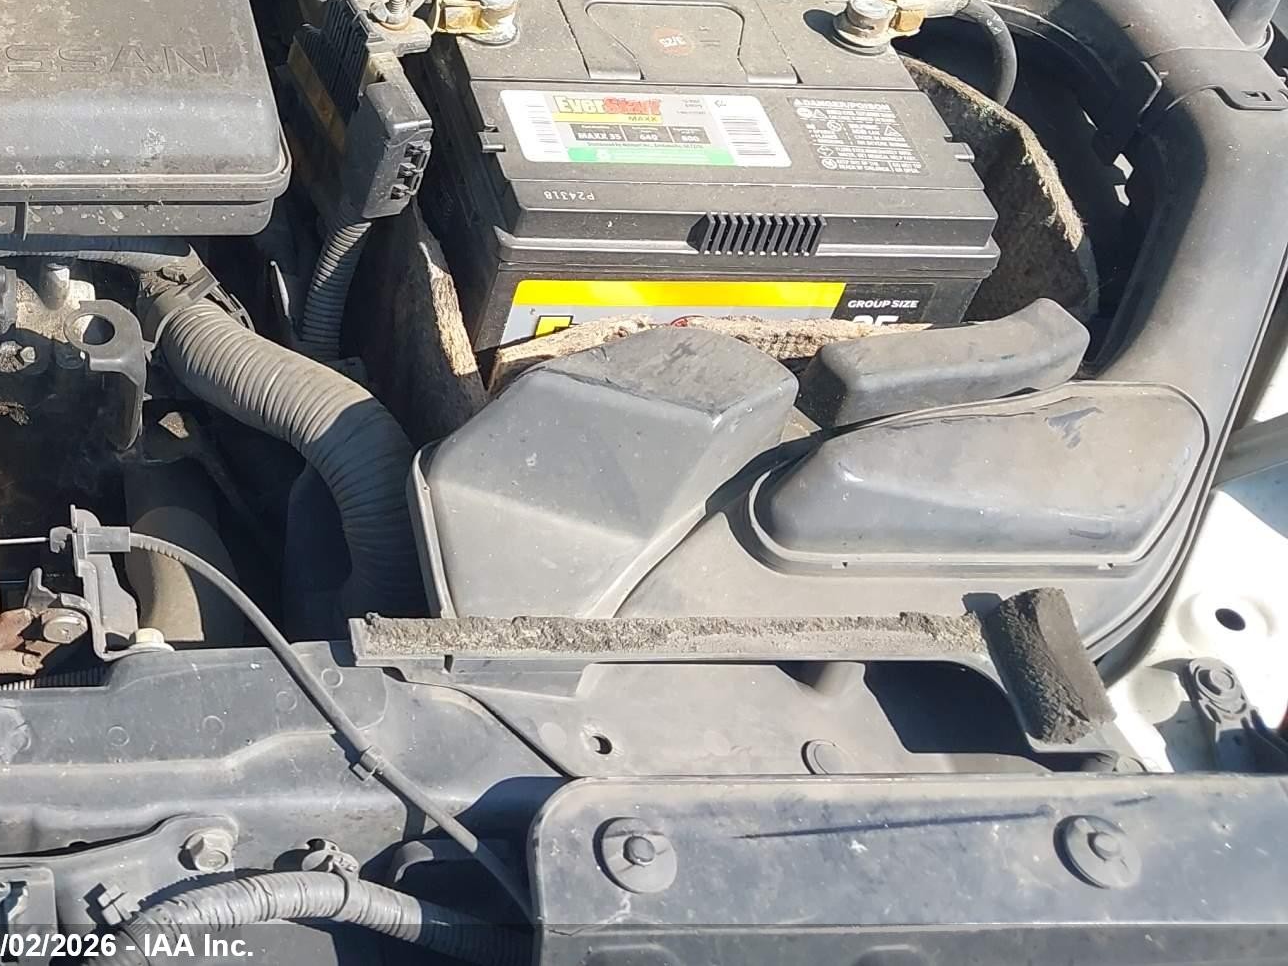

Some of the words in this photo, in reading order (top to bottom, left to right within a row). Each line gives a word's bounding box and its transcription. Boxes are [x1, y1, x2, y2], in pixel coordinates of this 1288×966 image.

[553, 95, 662, 115] EverStart
[578, 131, 608, 141] MAXX
[847, 300, 890, 308] GROUP
[890, 300, 919, 308] SIZE
